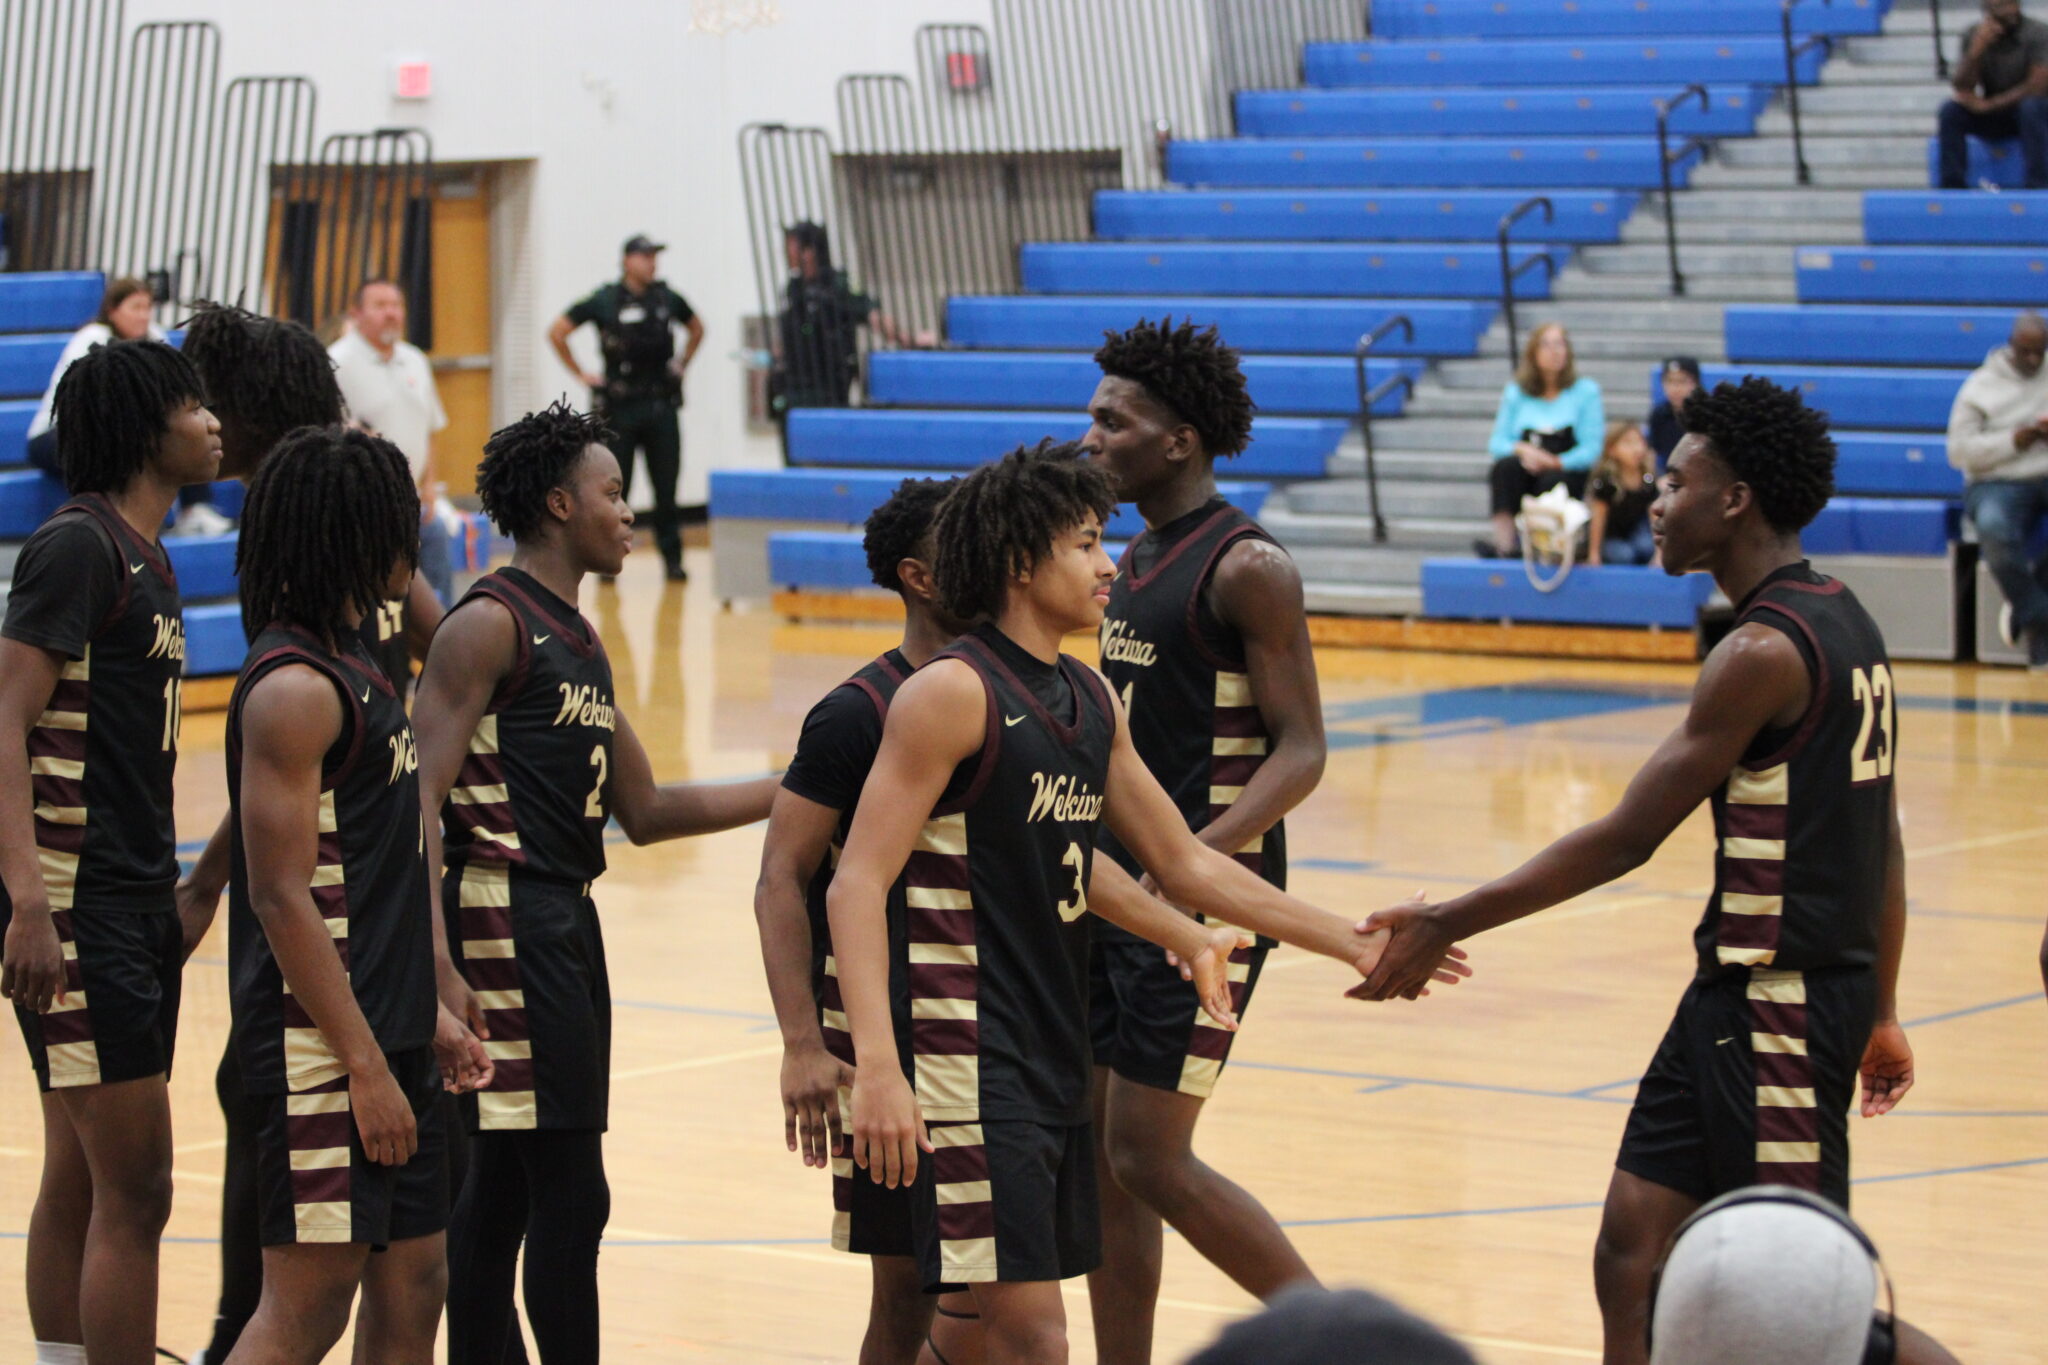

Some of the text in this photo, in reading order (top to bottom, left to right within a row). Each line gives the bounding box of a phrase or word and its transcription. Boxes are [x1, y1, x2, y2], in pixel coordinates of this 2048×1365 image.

[1850, 663, 1892, 782] 23
[584, 744, 607, 818] 2
[1057, 841, 1087, 923] 3
